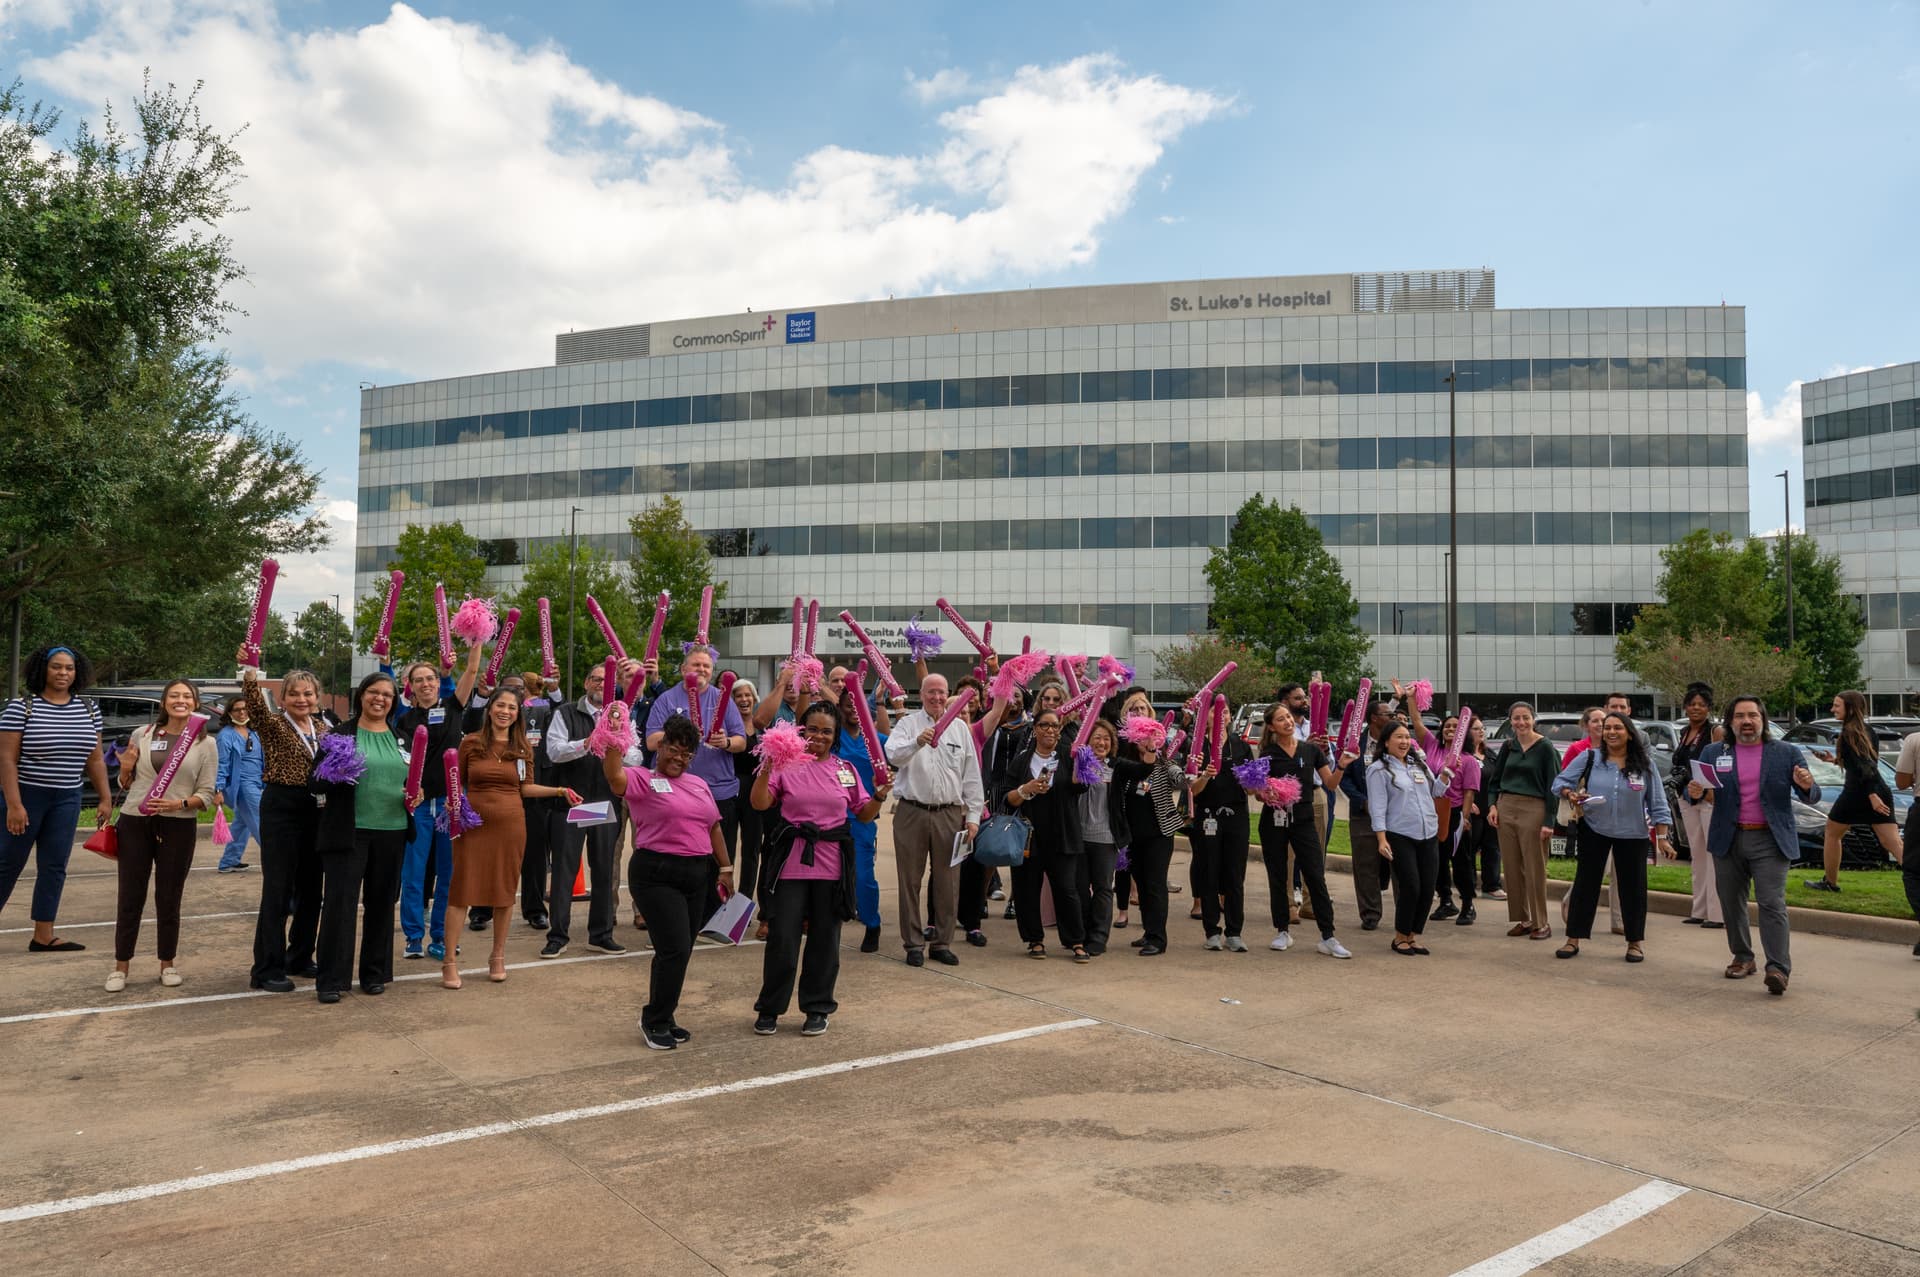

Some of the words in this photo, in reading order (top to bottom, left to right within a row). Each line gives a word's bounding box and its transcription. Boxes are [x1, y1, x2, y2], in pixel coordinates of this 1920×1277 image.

[1170, 297, 1193, 311] St.
[1199, 295, 1252, 310] Luke's
[1258, 290, 1331, 309] Hospital
[790, 319, 811, 328] Baylor
[673, 328, 766, 349] CommonSpirit
[490, 621, 515, 673] CommonSpirit
[150, 733, 193, 799] CommonSpirit
